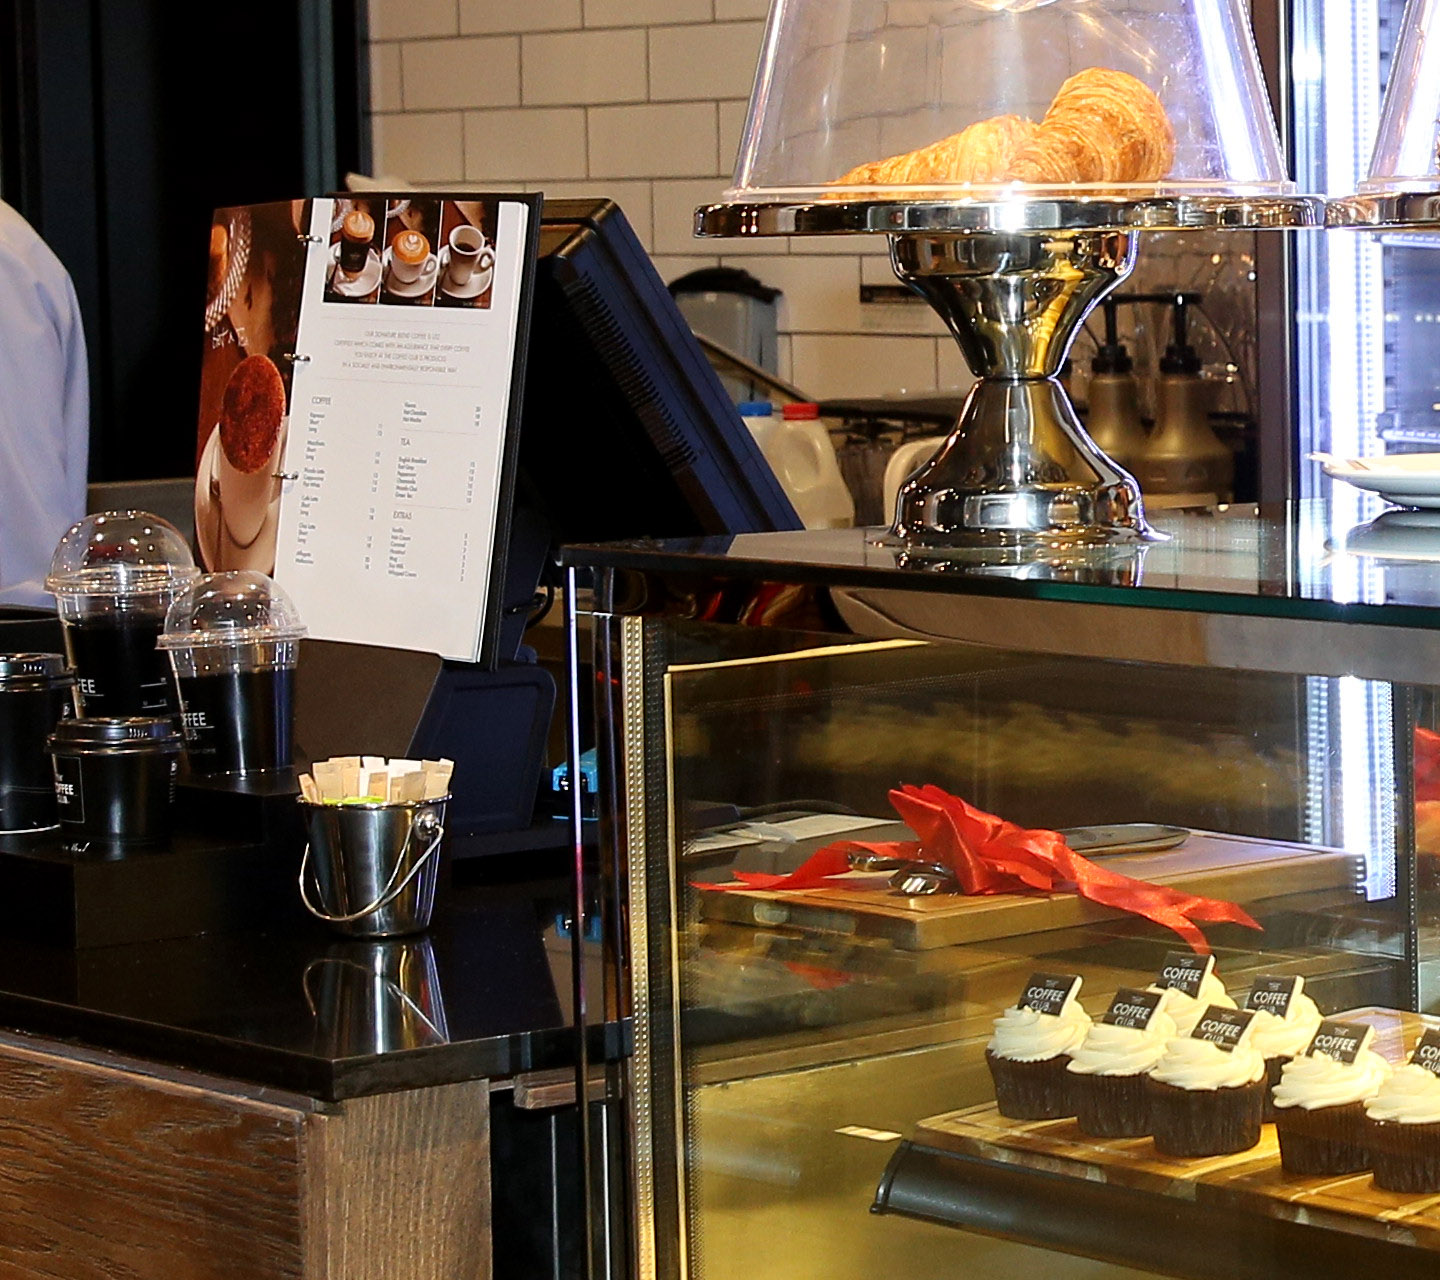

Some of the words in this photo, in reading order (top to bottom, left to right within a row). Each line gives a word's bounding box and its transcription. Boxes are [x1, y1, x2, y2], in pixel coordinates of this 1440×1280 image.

[1163, 967, 1201, 982] COFFEE
[1027, 987, 1065, 1002] COFFEE
[1253, 991, 1288, 1007] COFFEE
[1113, 1003, 1151, 1019] COFFEE
[1201, 1020, 1241, 1037] COFFEE
[1315, 1035, 1357, 1051] COFFEE
